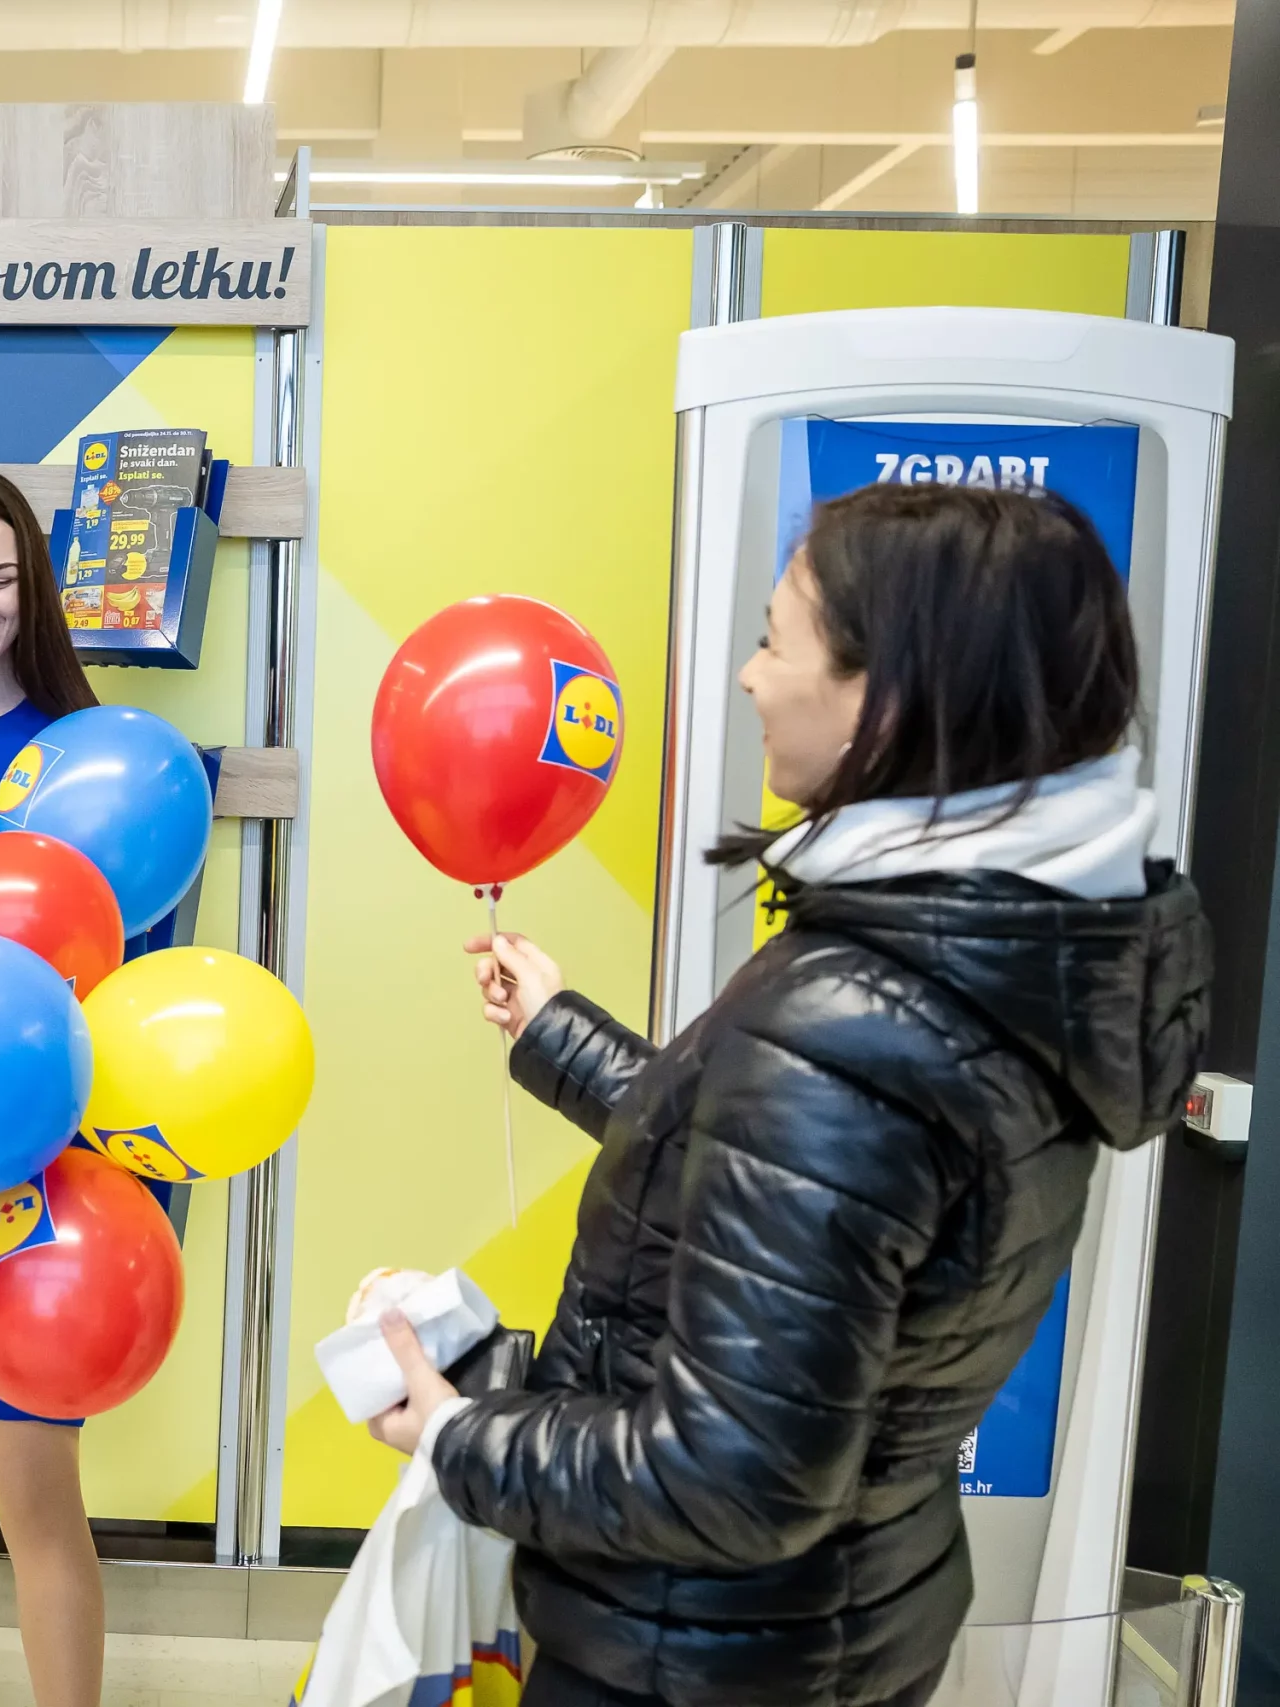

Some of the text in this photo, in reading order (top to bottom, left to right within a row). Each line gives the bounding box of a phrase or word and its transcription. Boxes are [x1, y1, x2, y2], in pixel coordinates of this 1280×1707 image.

[131, 246, 296, 301] letku!
[120, 443, 195, 458] Snižendan
[119, 458, 178, 470] je svaki dan.
[119, 471, 165, 482] Isplati se.
[109, 533, 145, 551] 29.99
